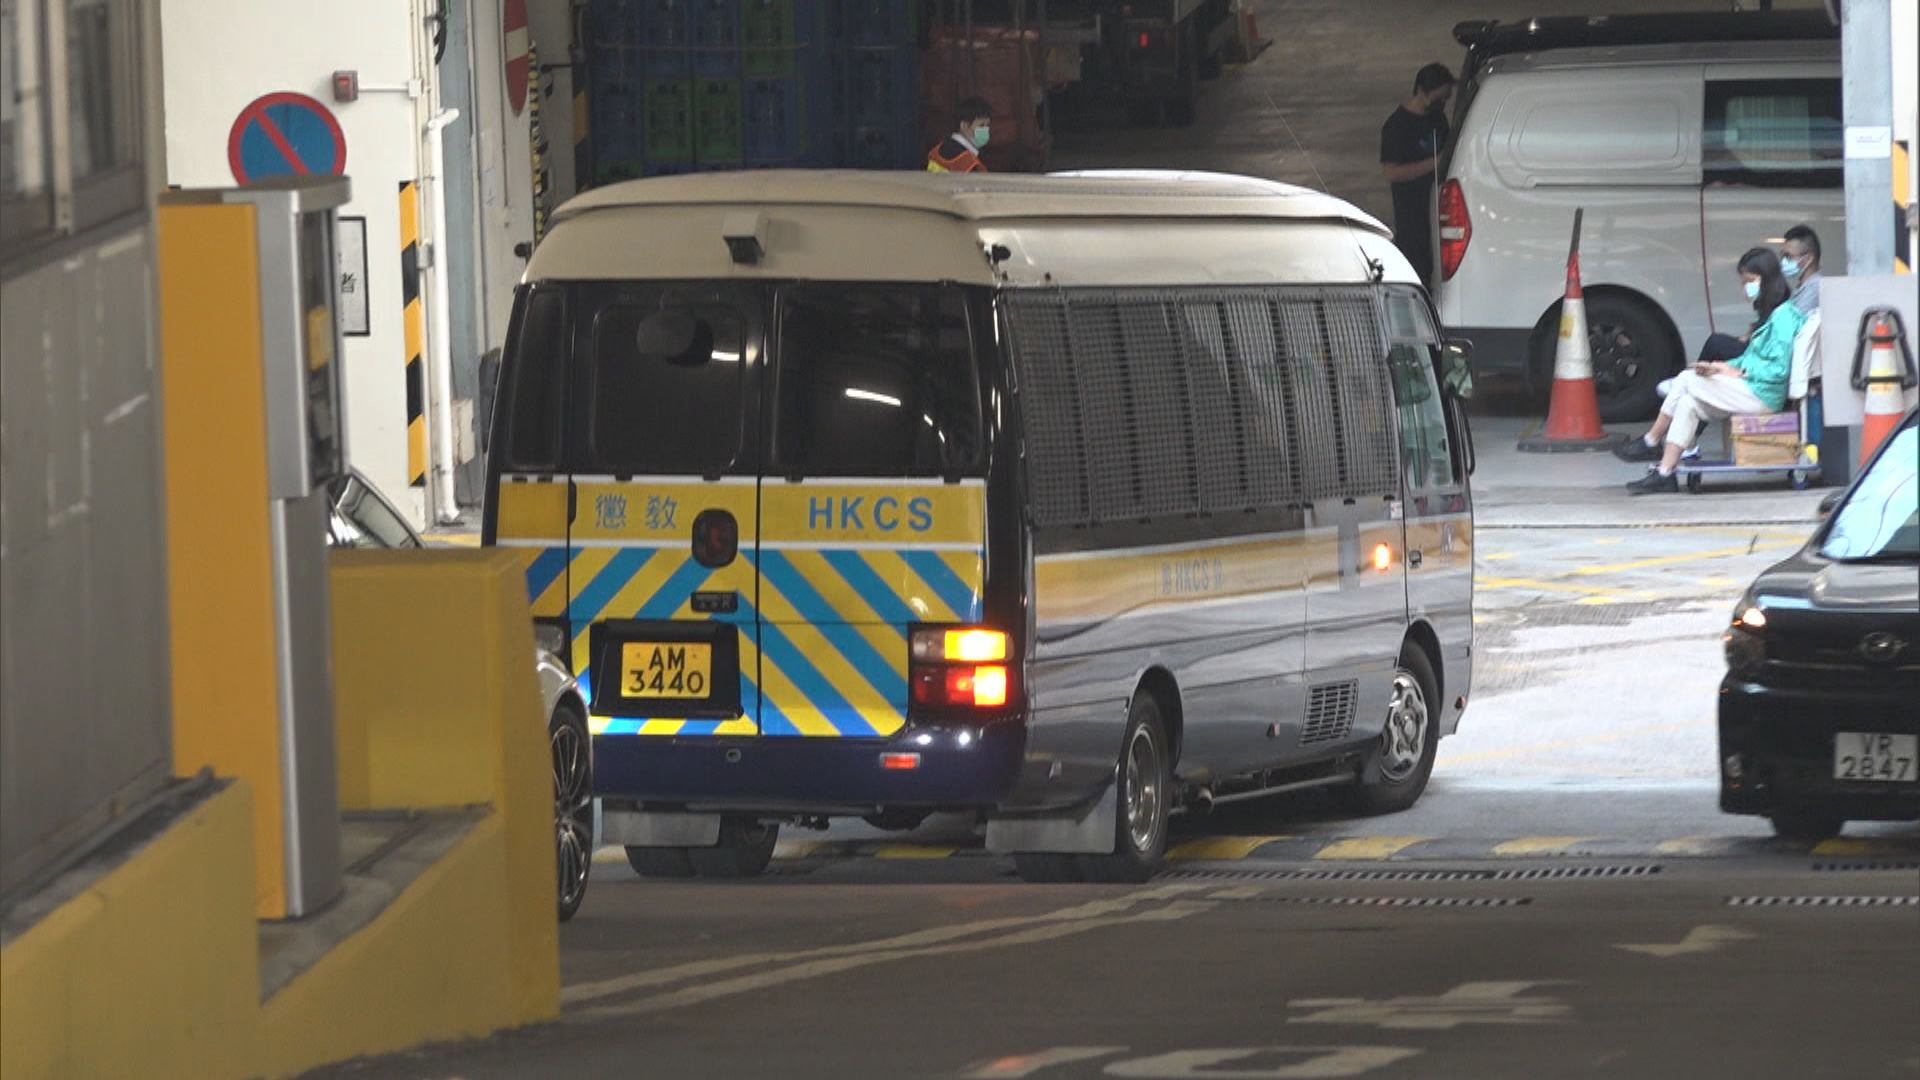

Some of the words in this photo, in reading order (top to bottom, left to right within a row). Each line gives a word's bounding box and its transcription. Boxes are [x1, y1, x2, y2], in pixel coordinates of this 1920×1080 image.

[809, 496, 933, 532] HKCS
[649, 646, 685, 670] AM
[629, 668, 705, 694] 3440
[1861, 733, 1894, 757] VR
[1841, 756, 1911, 779] 2847
